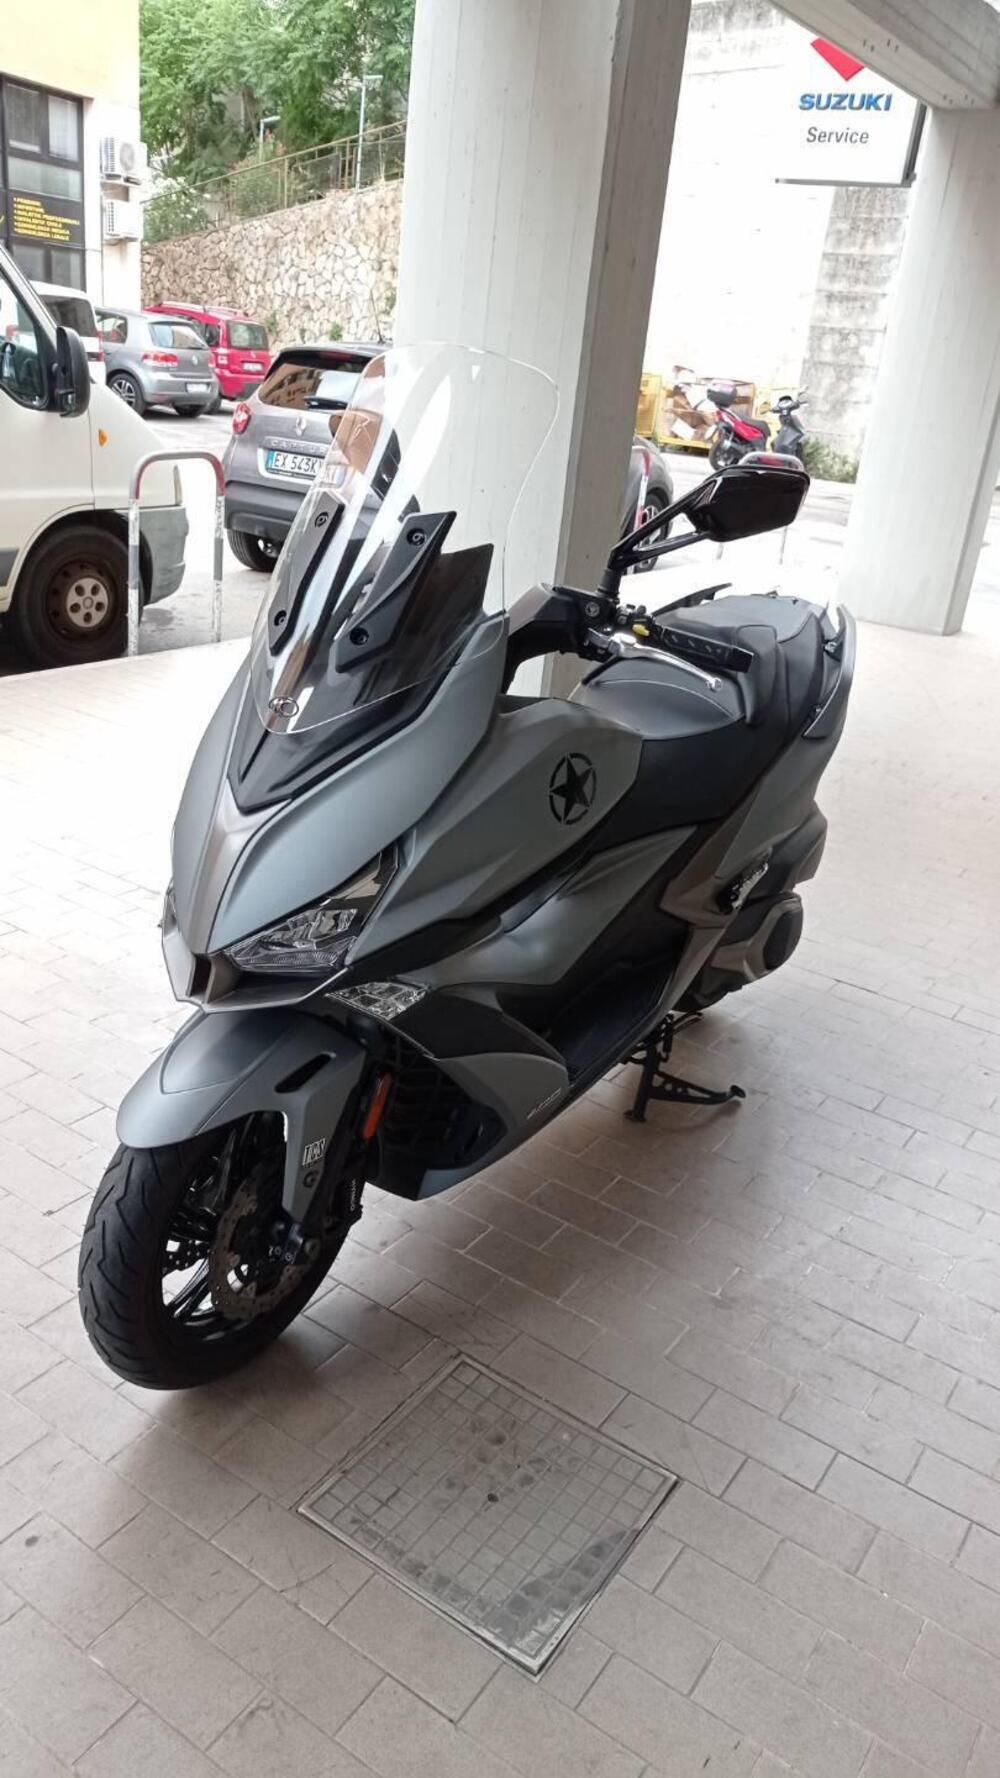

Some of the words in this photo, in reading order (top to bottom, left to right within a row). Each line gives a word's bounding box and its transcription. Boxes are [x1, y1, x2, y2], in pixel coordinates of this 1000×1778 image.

[799, 93, 893, 111] SUZUKI
[806, 126, 869, 144] Service
[274, 452, 288, 469] EX
